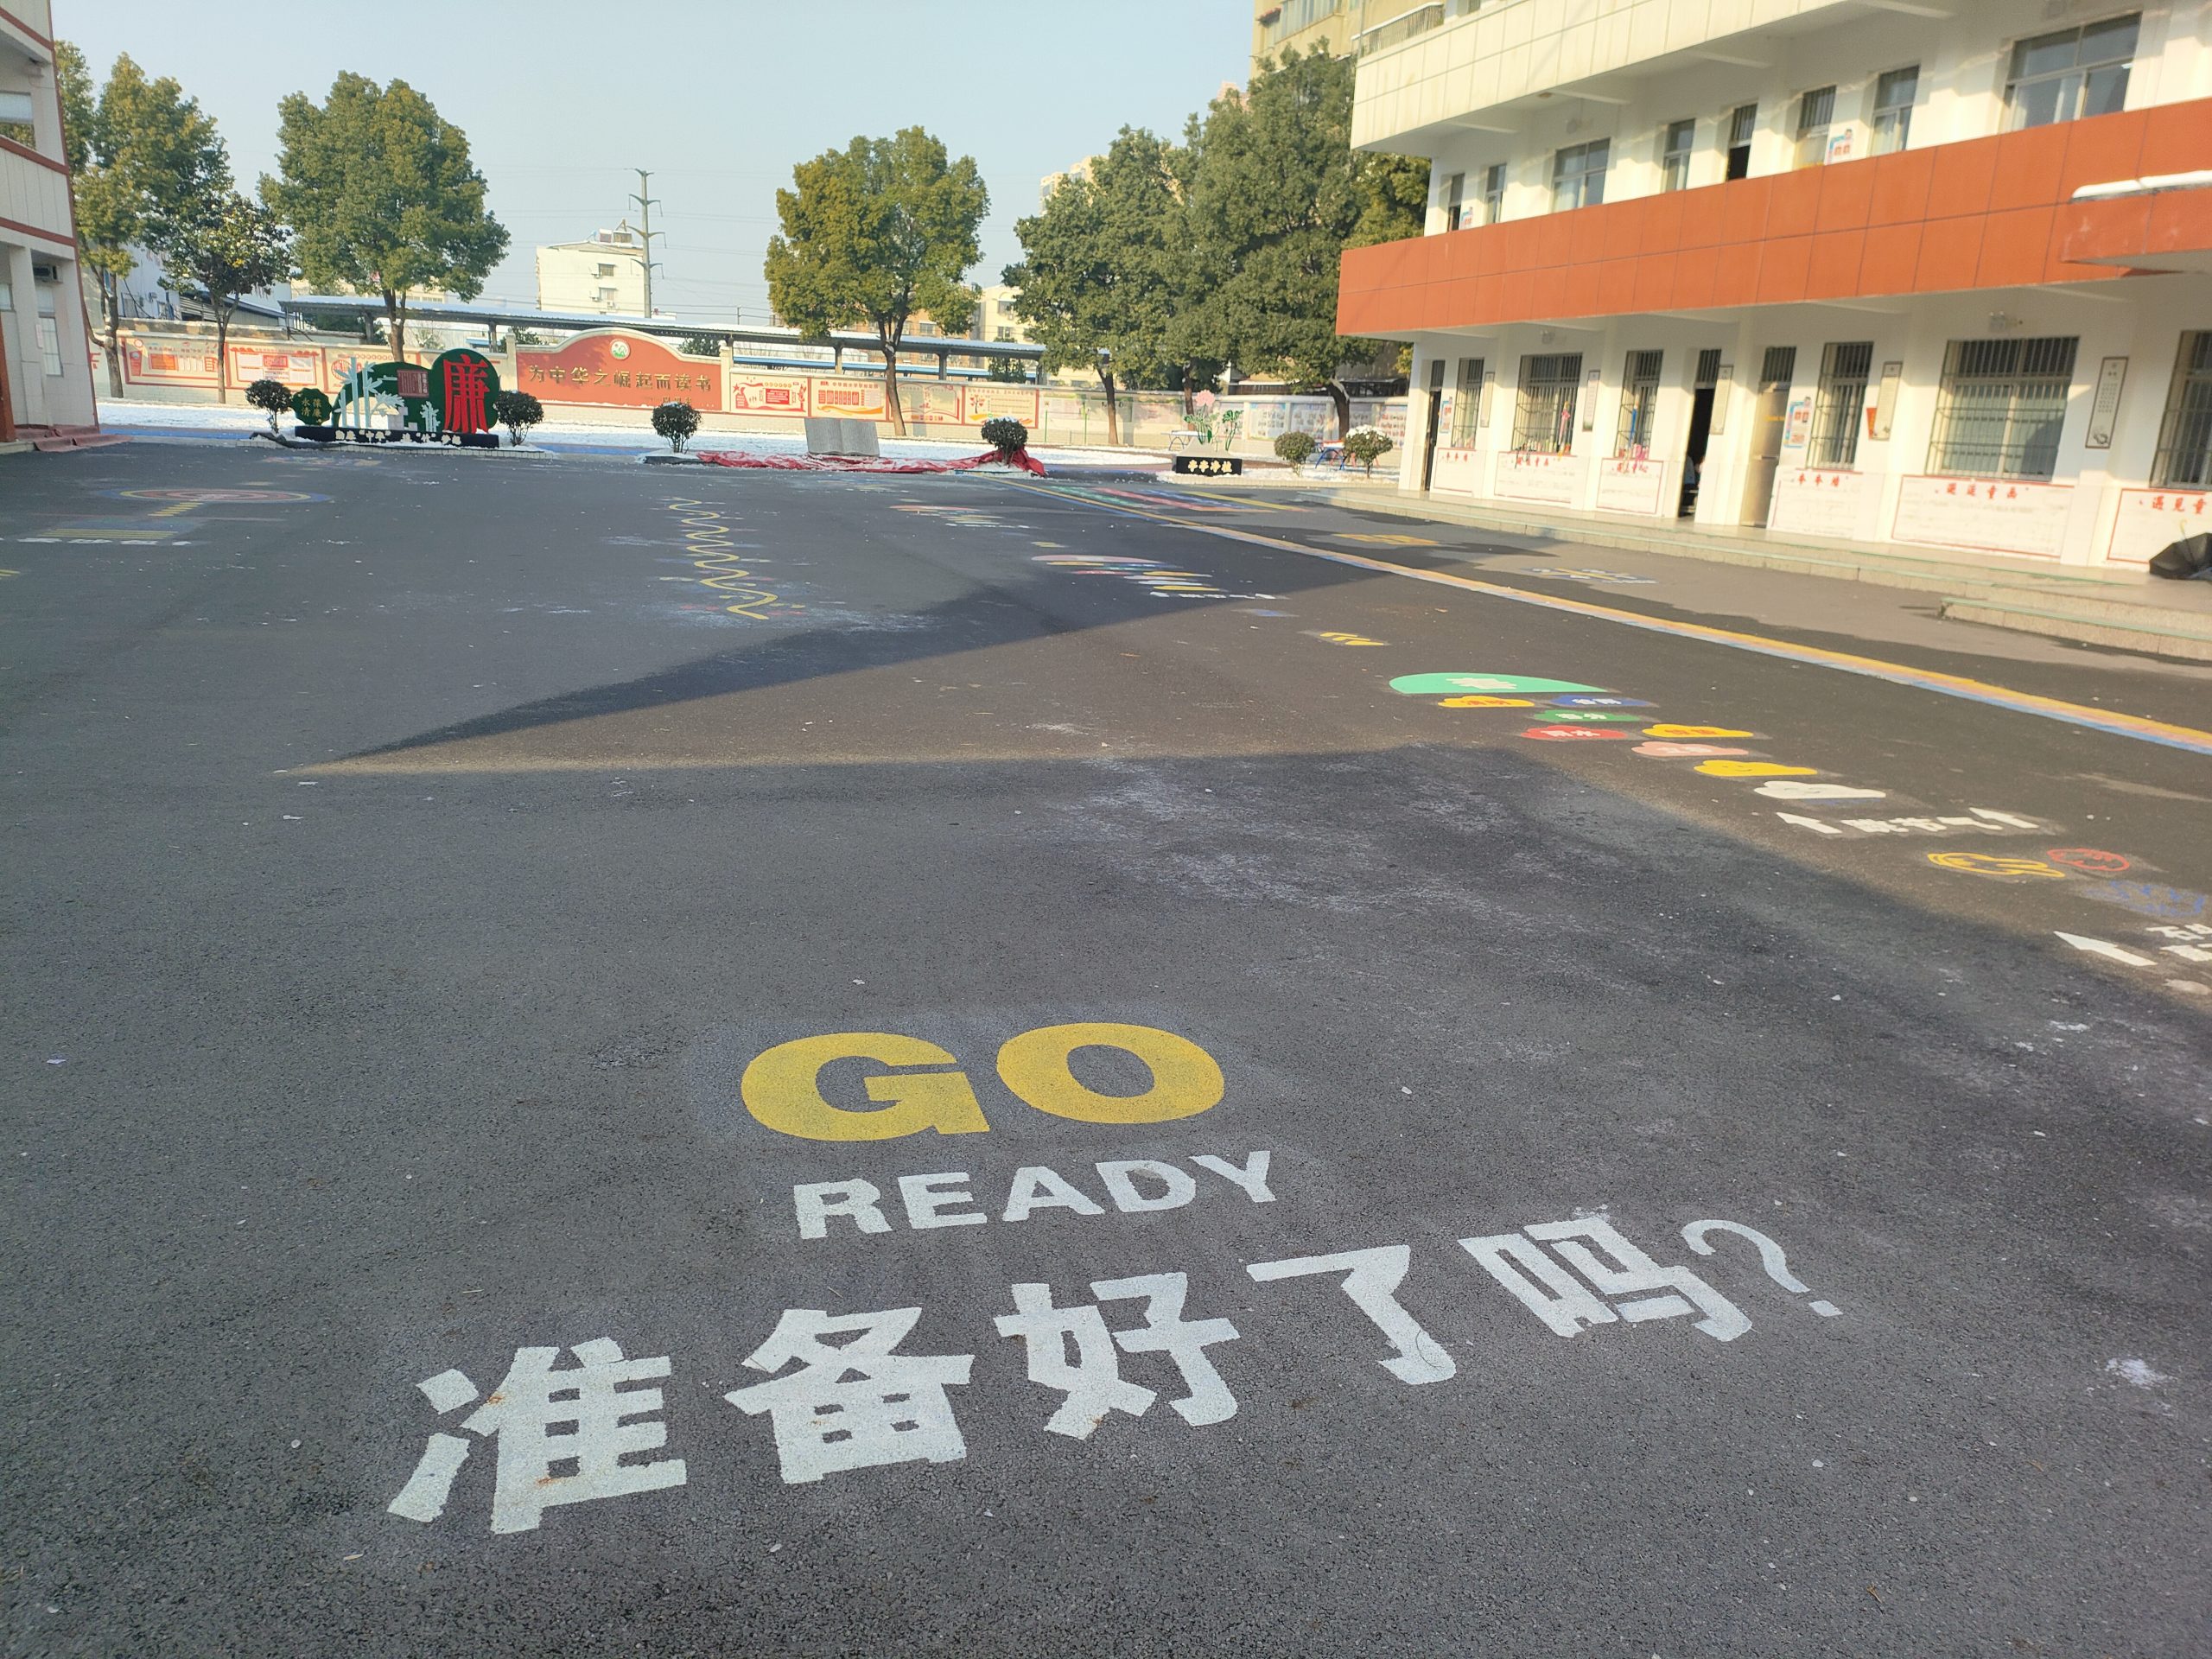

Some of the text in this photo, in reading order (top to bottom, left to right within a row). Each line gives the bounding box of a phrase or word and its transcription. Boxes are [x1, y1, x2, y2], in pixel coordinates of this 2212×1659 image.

[442, 354, 490, 434] 廉
[528, 365, 711, 392] 为中华之崛起而读书
[741, 1022, 1225, 1142] GO
[792, 1149, 1276, 1241] READY
[387, 1212, 1843, 1536] 准备好了吗？
